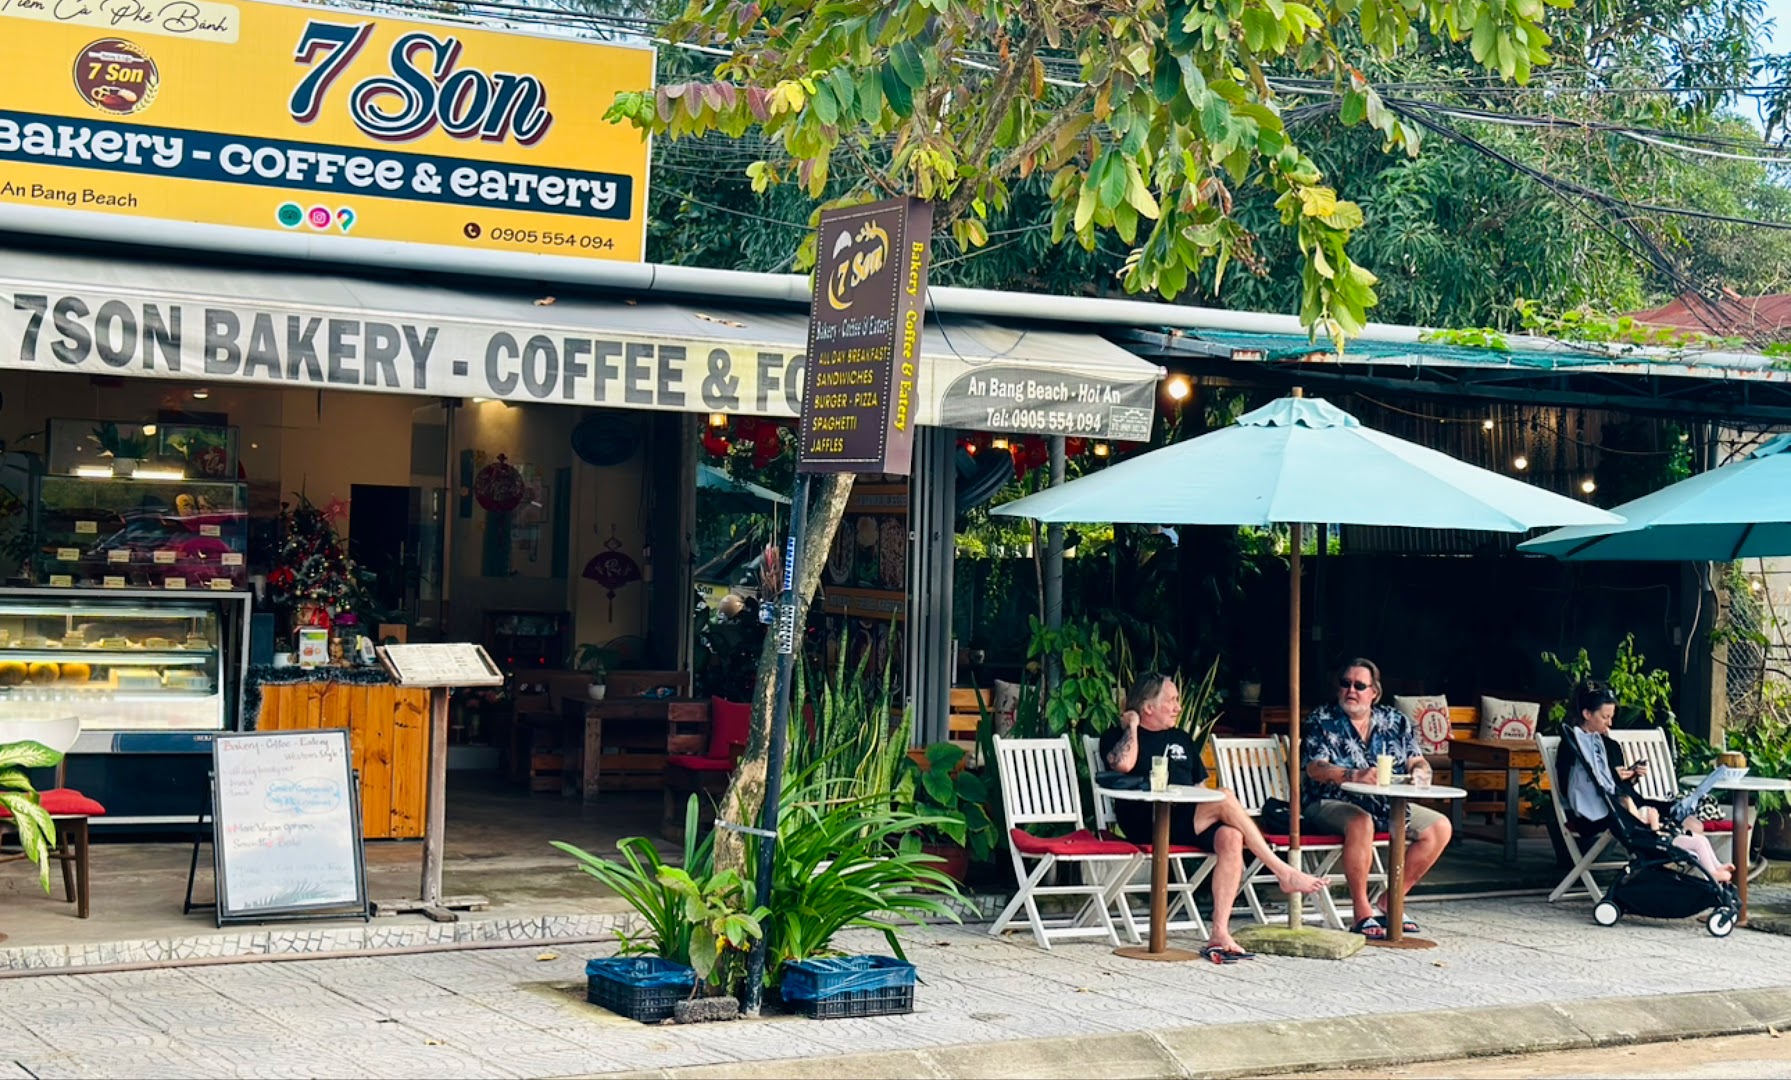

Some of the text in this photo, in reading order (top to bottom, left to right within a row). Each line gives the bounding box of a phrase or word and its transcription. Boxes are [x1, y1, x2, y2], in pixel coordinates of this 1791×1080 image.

[88, 62, 144, 83] 7 Son
[288, 19, 553, 146] 7 Son
[411, 162, 442, 195] &
[0, 181, 138, 208] An Bang Beach
[490, 227, 615, 250] 0905 554 094
[836, 245, 884, 297] 7 Son
[905, 240, 926, 297] Bakery
[816, 321, 837, 343] Bakery
[842, 318, 861, 338] Coffee
[868, 315, 889, 338] Eatery
[902, 309, 920, 358] Coffee
[13, 293, 182, 372] 7SON
[204, 308, 439, 390] BAKERY
[485, 331, 686, 407] COFFEE
[701, 348, 740, 411] &
[819, 346, 887, 366] ALL DAY BREAKFAST
[816, 369, 874, 387] SANDWICHES
[901, 363, 915, 376] &
[814, 393, 847, 409] BURGER
[855, 392, 879, 407] PIZZA
[968, 376, 986, 396] An
[989, 378, 1024, 401] Bang
[1027, 381, 1068, 401] Beach
[1078, 384, 1100, 402] Hoi
[1103, 385, 1121, 404] An
[893, 380, 914, 432] Eatery
[812, 415, 858, 432] SPAGHETTI
[986, 408, 1009, 428] Tel:
[1011, 409, 1045, 430] 0905
[1049, 412, 1073, 432] 554
[1076, 414, 1101, 432] 094
[810, 437, 844, 453] JAFFLES
[223, 740, 260, 754] Bakery
